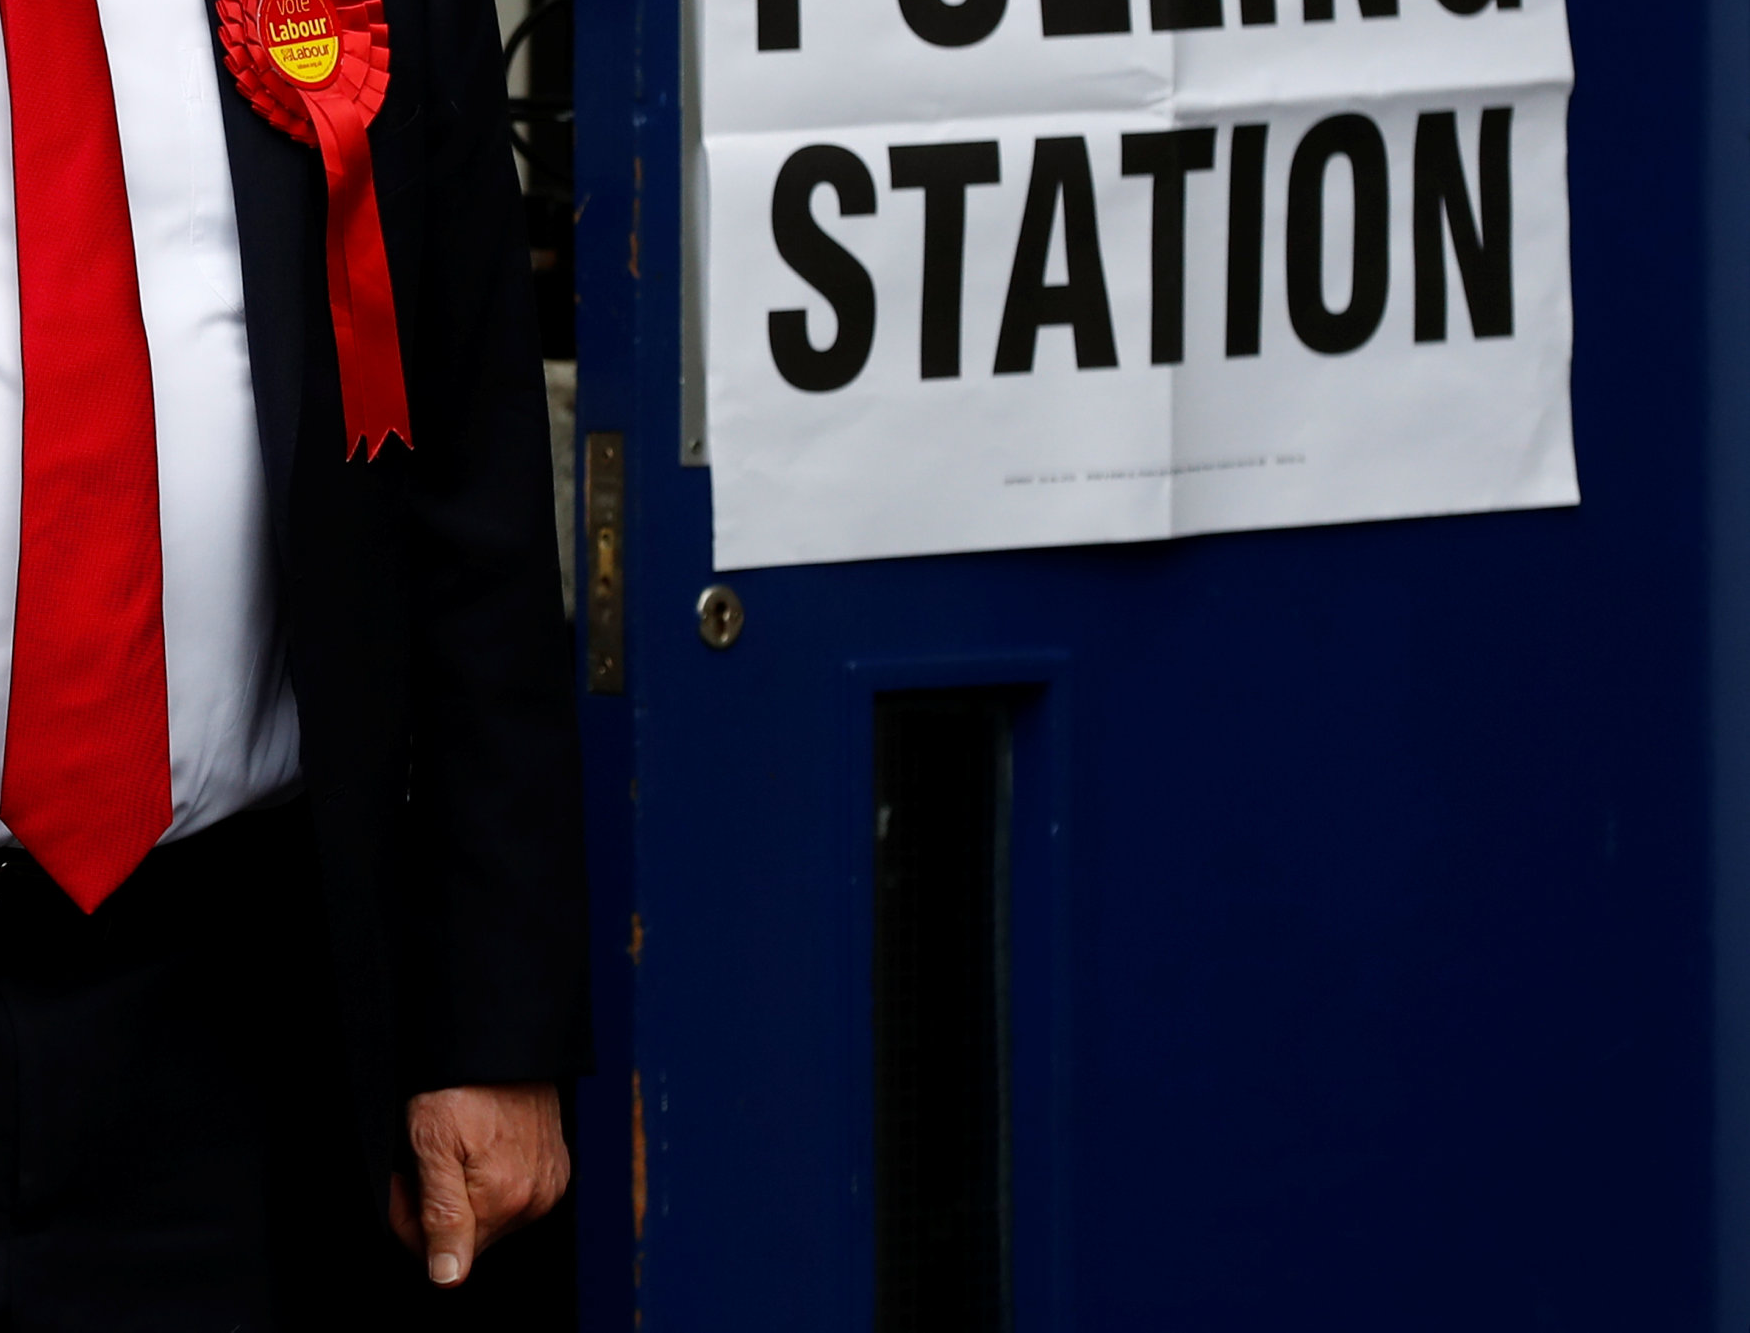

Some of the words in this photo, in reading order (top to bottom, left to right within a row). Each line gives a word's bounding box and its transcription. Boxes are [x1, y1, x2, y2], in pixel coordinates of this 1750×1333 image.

[269, 17, 327, 42] Labour
[290, 43, 331, 61] Labour
[768, 105, 1514, 393] STATION
